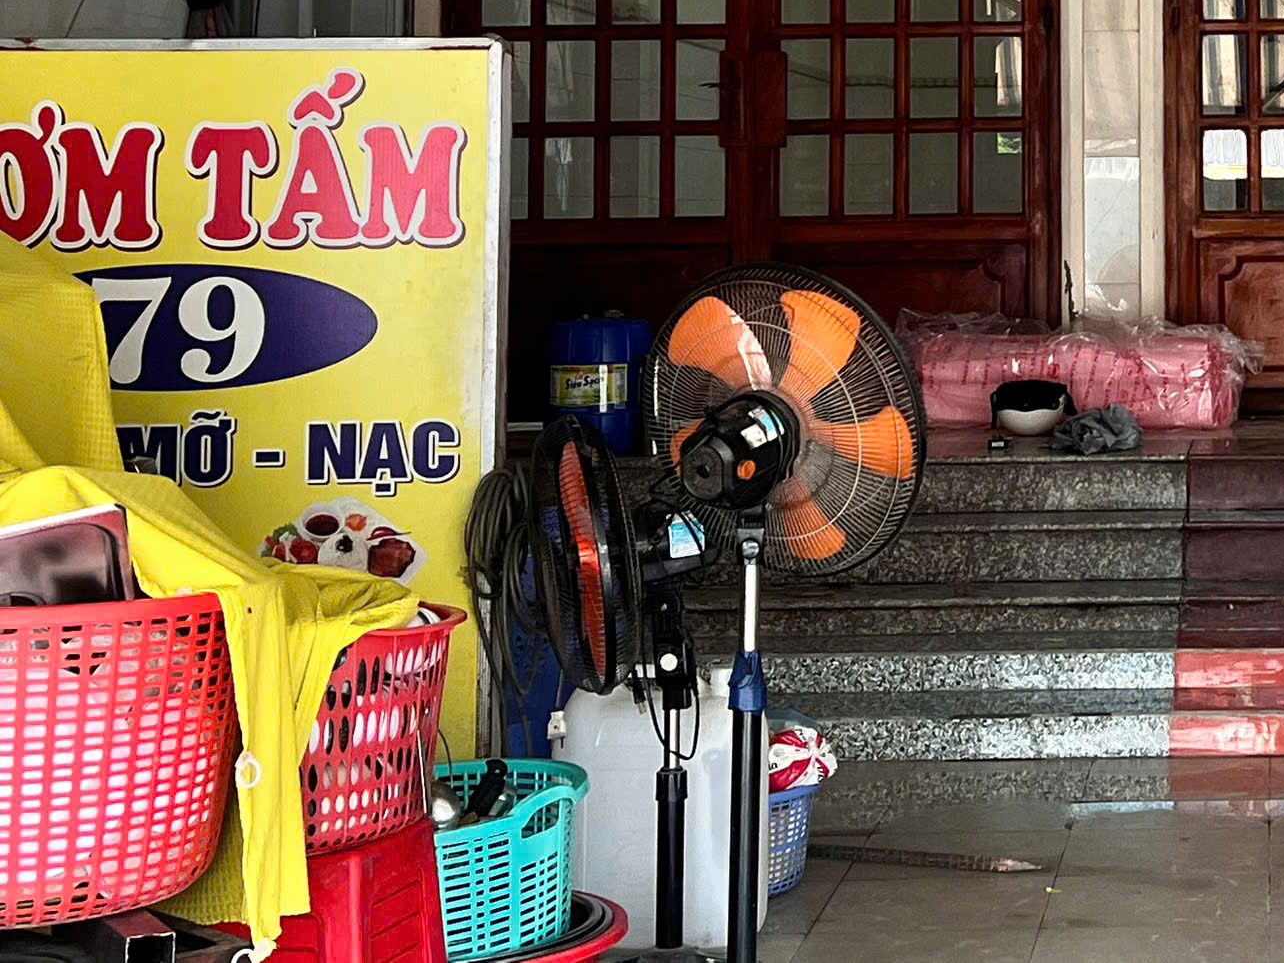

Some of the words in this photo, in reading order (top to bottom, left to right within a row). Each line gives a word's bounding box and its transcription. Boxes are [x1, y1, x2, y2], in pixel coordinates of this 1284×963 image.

[185, 67, 467, 250] TẤM
[92, 275, 266, 384] 79
[115, 410, 238, 487] MỠ
[306, 419, 461, 496] NẠC
